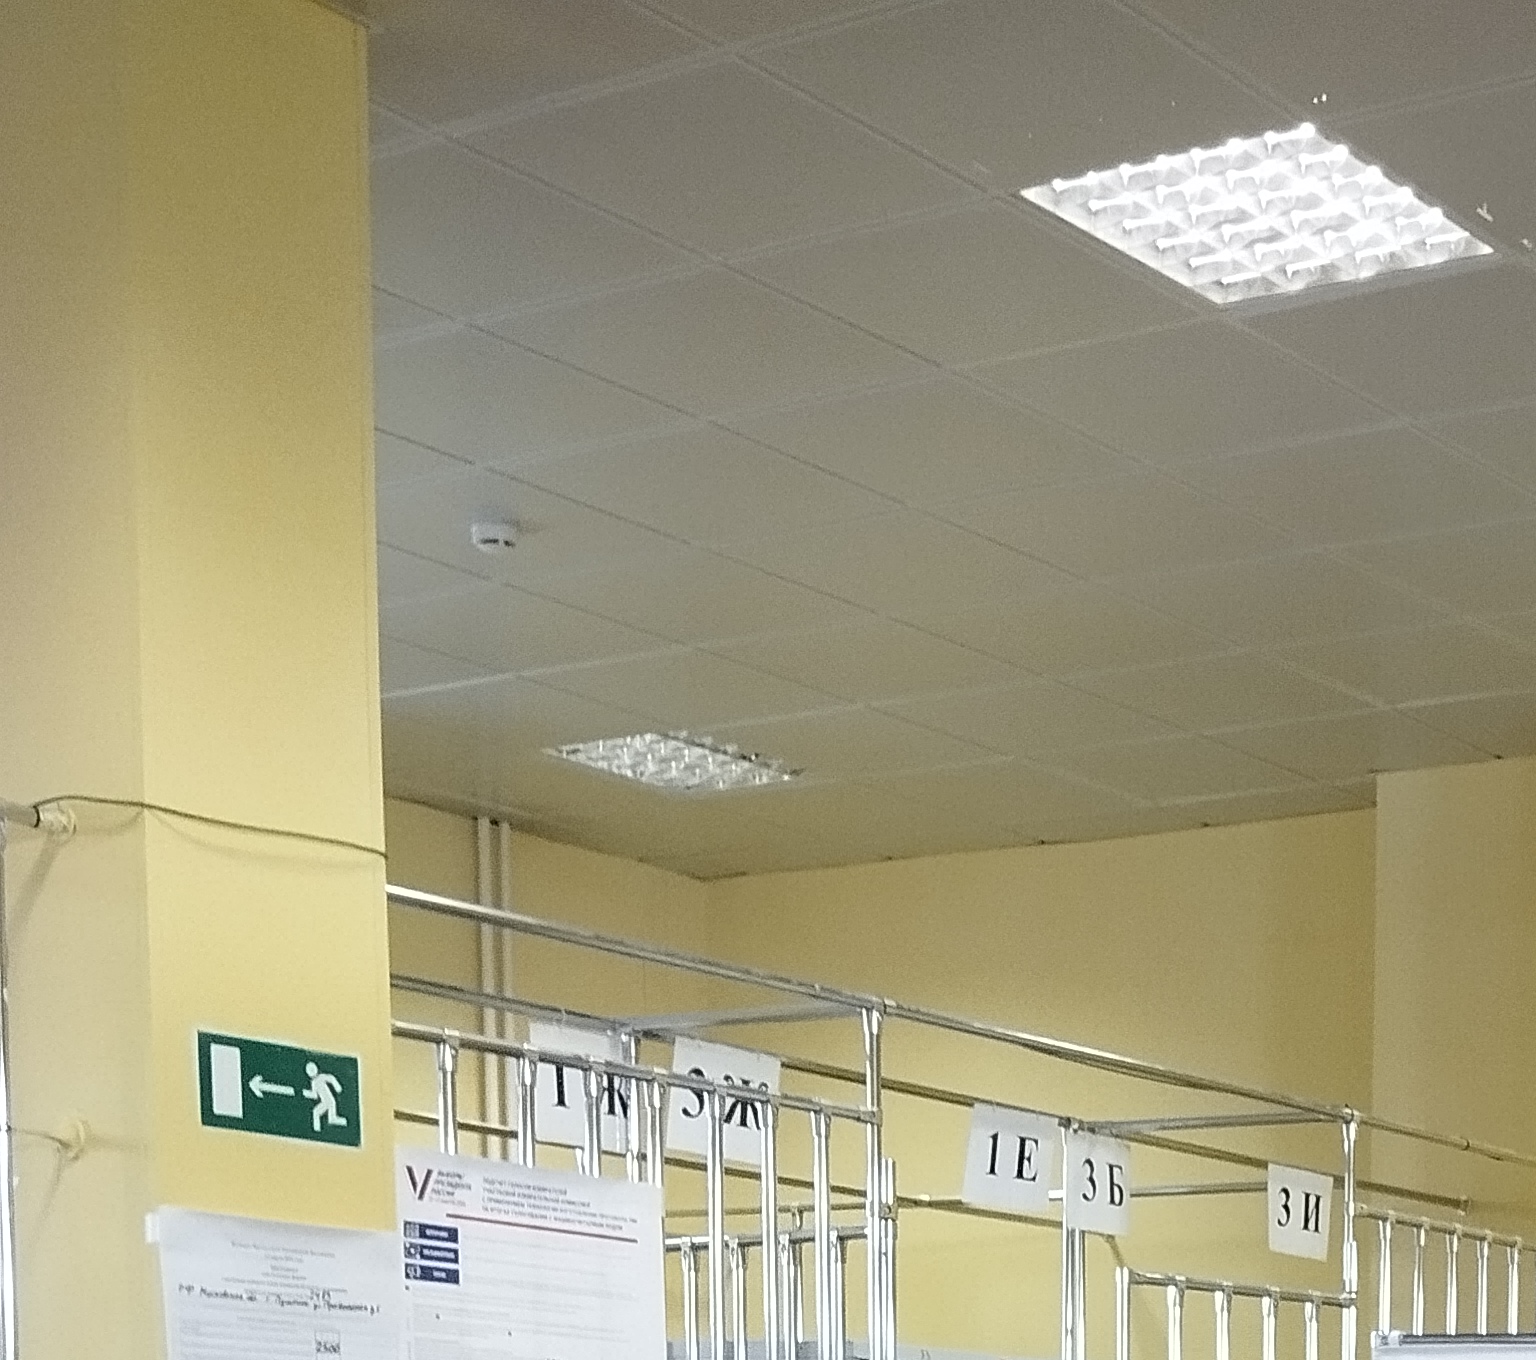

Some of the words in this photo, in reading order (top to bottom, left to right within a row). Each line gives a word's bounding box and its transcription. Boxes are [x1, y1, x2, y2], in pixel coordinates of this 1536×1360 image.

[985, 1131, 1000, 1177] 1
[1013, 1135, 1041, 1183] Е
[1080, 1157, 1099, 1203] 3
[1106, 1162, 1125, 1208] Б
[1276, 1187, 1293, 1229] 3
[1301, 1190, 1324, 1235] И
